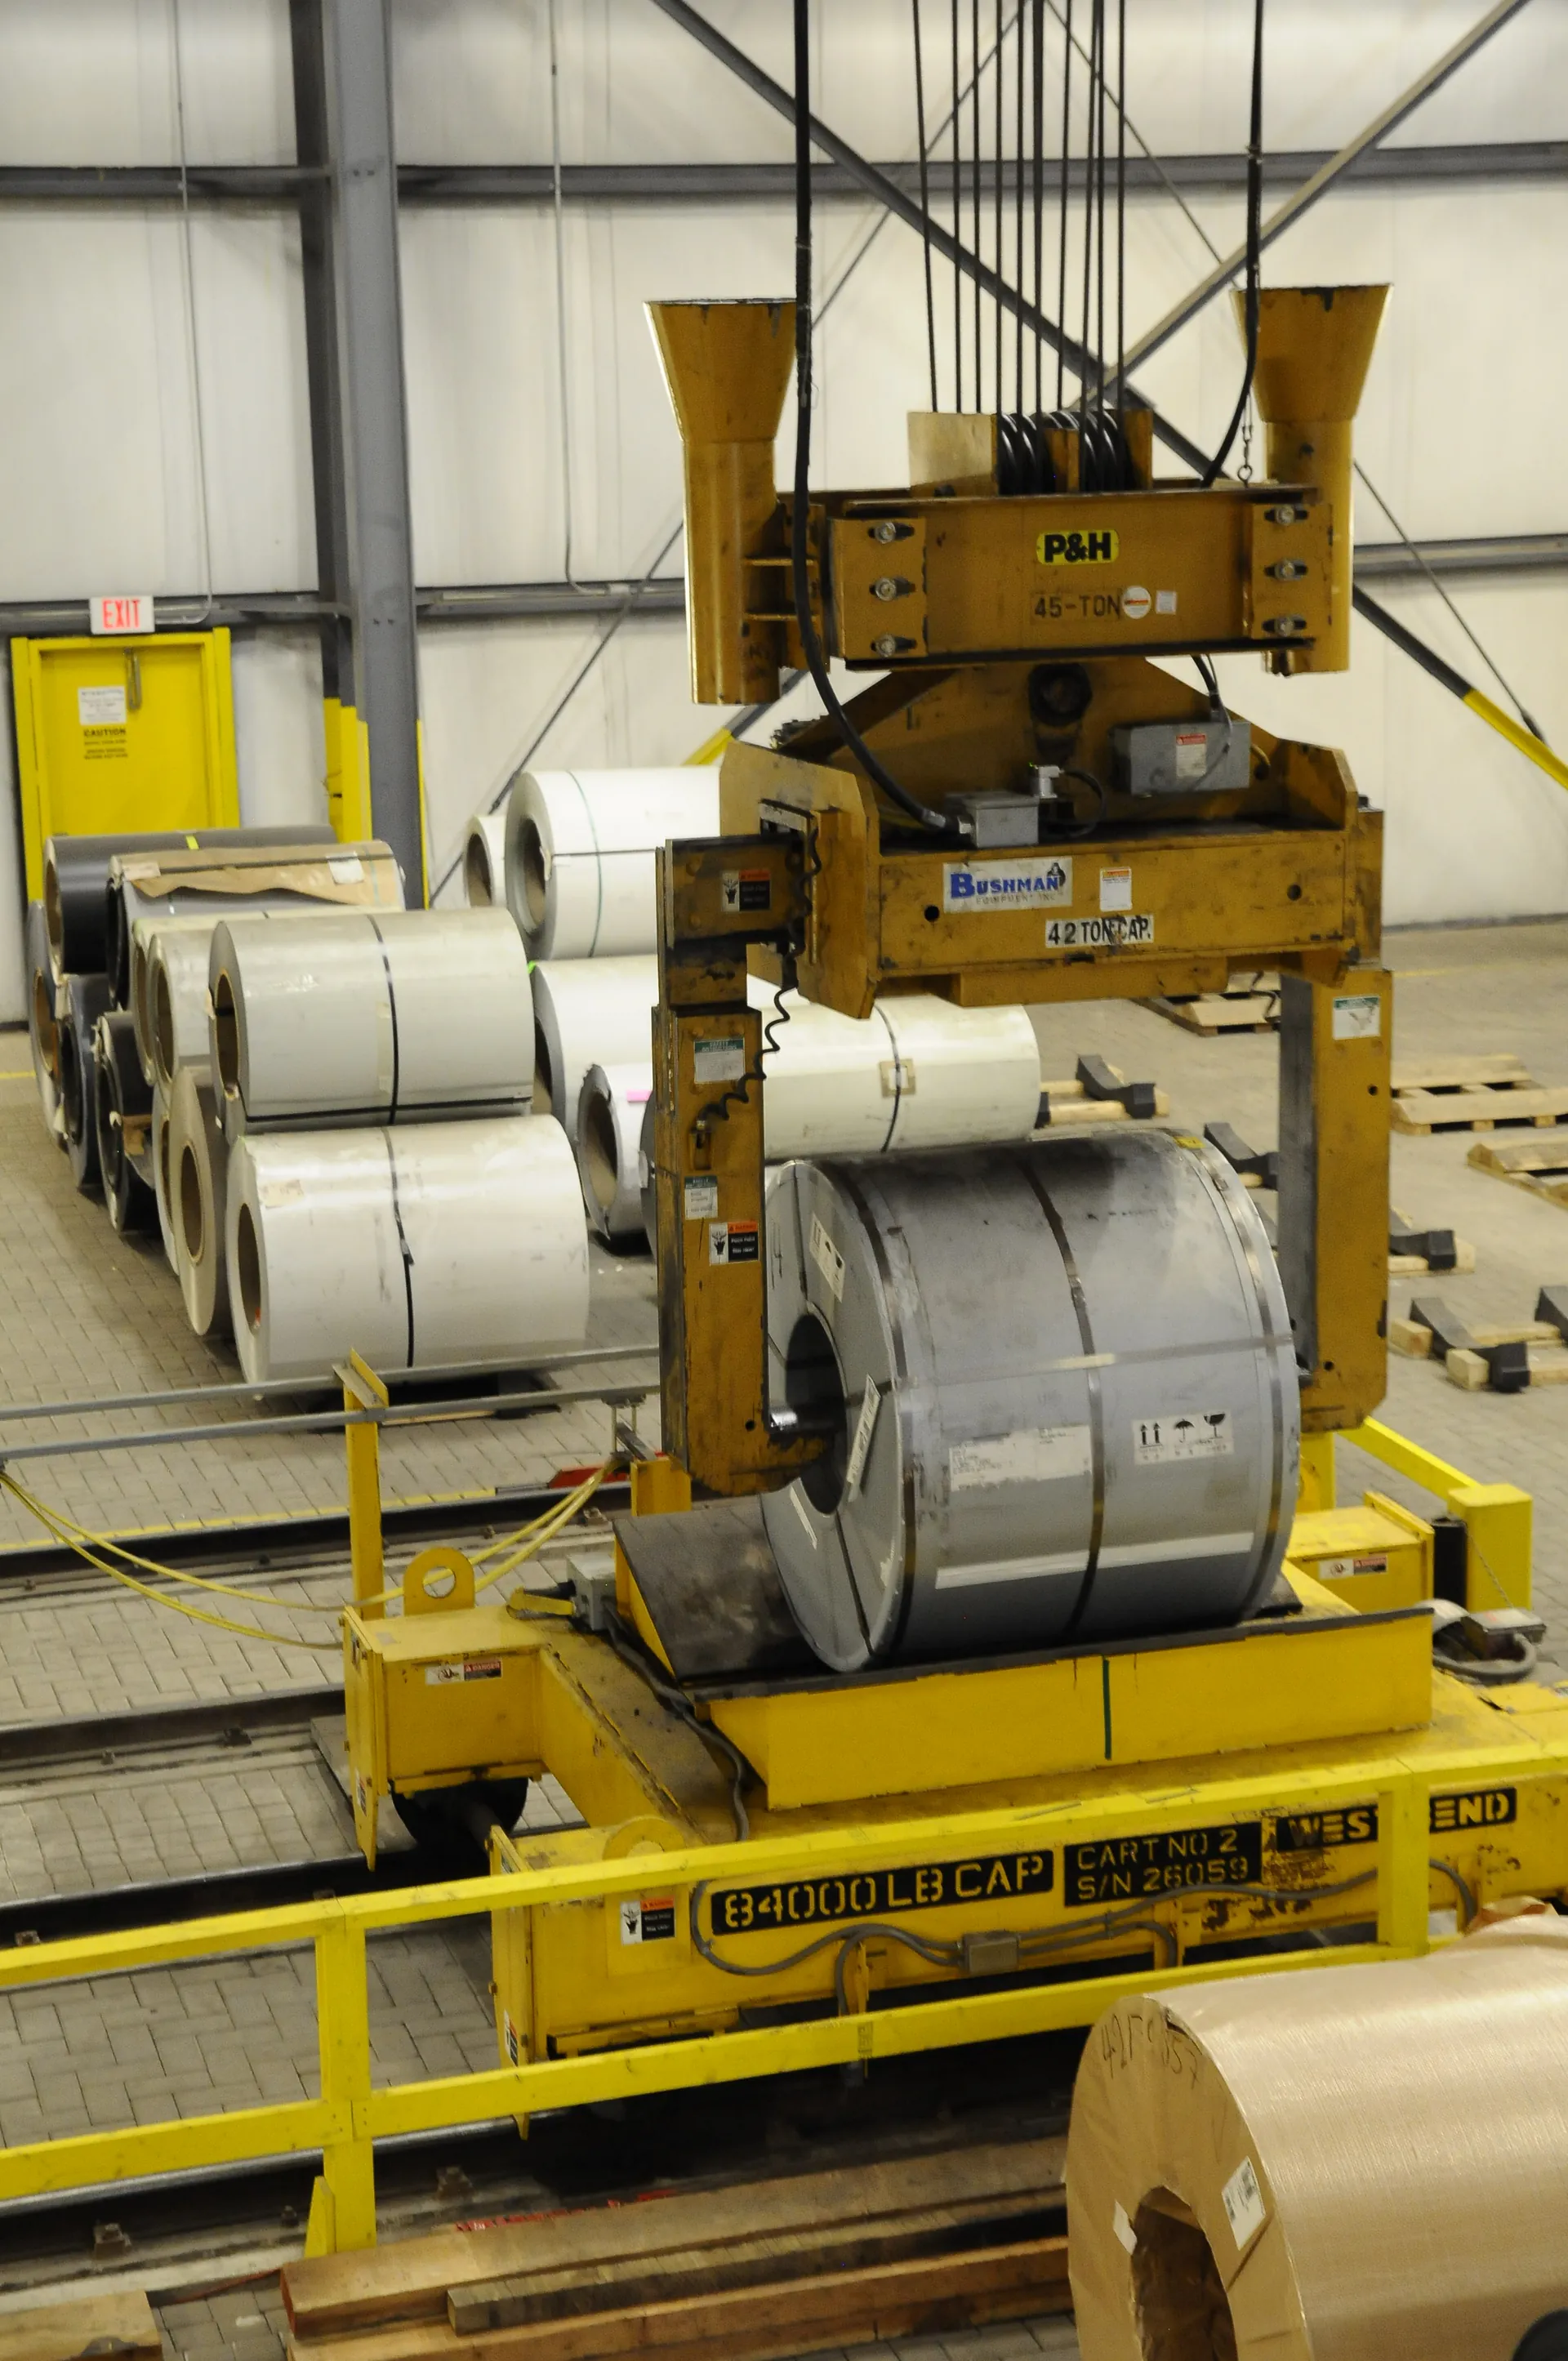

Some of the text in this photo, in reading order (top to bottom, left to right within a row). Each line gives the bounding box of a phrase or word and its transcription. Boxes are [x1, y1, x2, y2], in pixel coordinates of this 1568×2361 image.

[1045, 532, 1111, 562] P&H
[102, 599, 140, 629] EXIT
[1035, 594, 1120, 618] 45-TON
[951, 872, 1060, 898] BUSHMAN
[1288, 1793, 1510, 1846] WES END
[1078, 1838, 1160, 1871] CART
[1219, 1829, 1238, 1853] 2
[725, 1855, 1044, 1927] 84000 LB CAP
[1077, 1871, 1131, 1900] S/N
